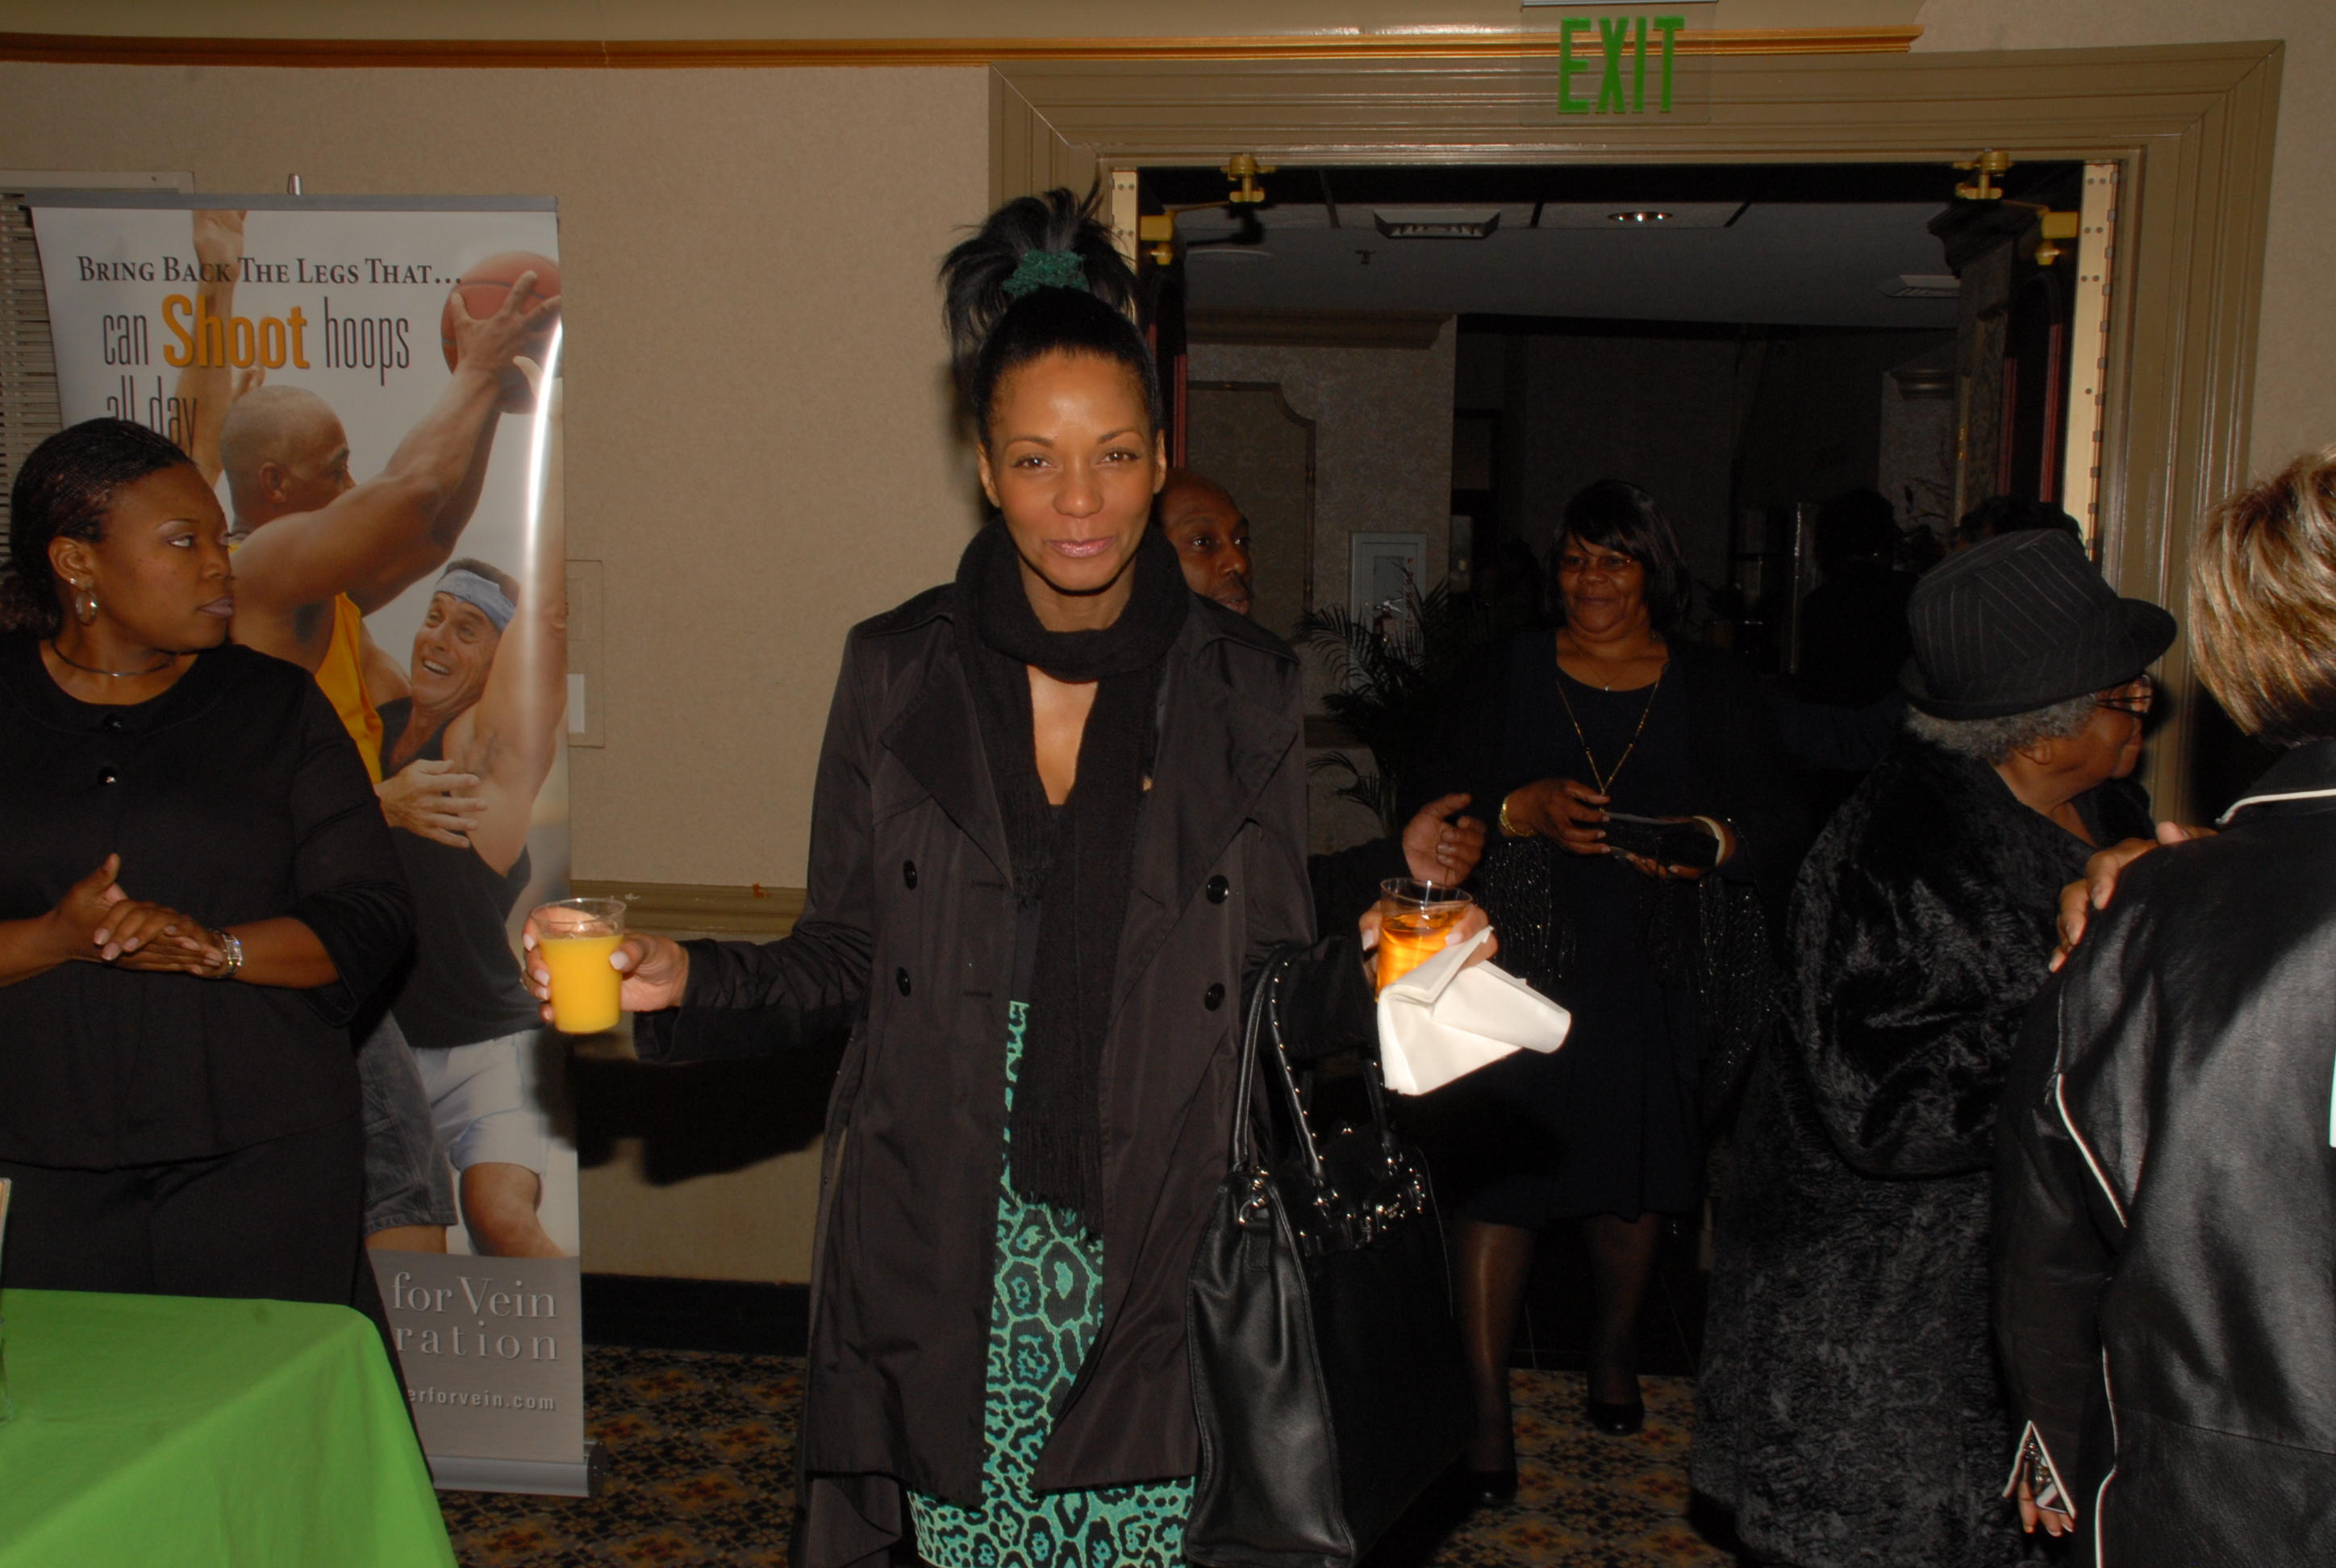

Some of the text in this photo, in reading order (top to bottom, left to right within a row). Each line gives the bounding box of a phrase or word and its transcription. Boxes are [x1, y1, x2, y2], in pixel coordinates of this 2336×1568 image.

[1558, 15, 1686, 115] EXIT
[77, 256, 462, 284] BRING BACK THE LEGS THAT...
[102, 294, 410, 386] can Shoot hoops
[149, 375, 198, 458] day
[395, 1320, 561, 1361] ration
